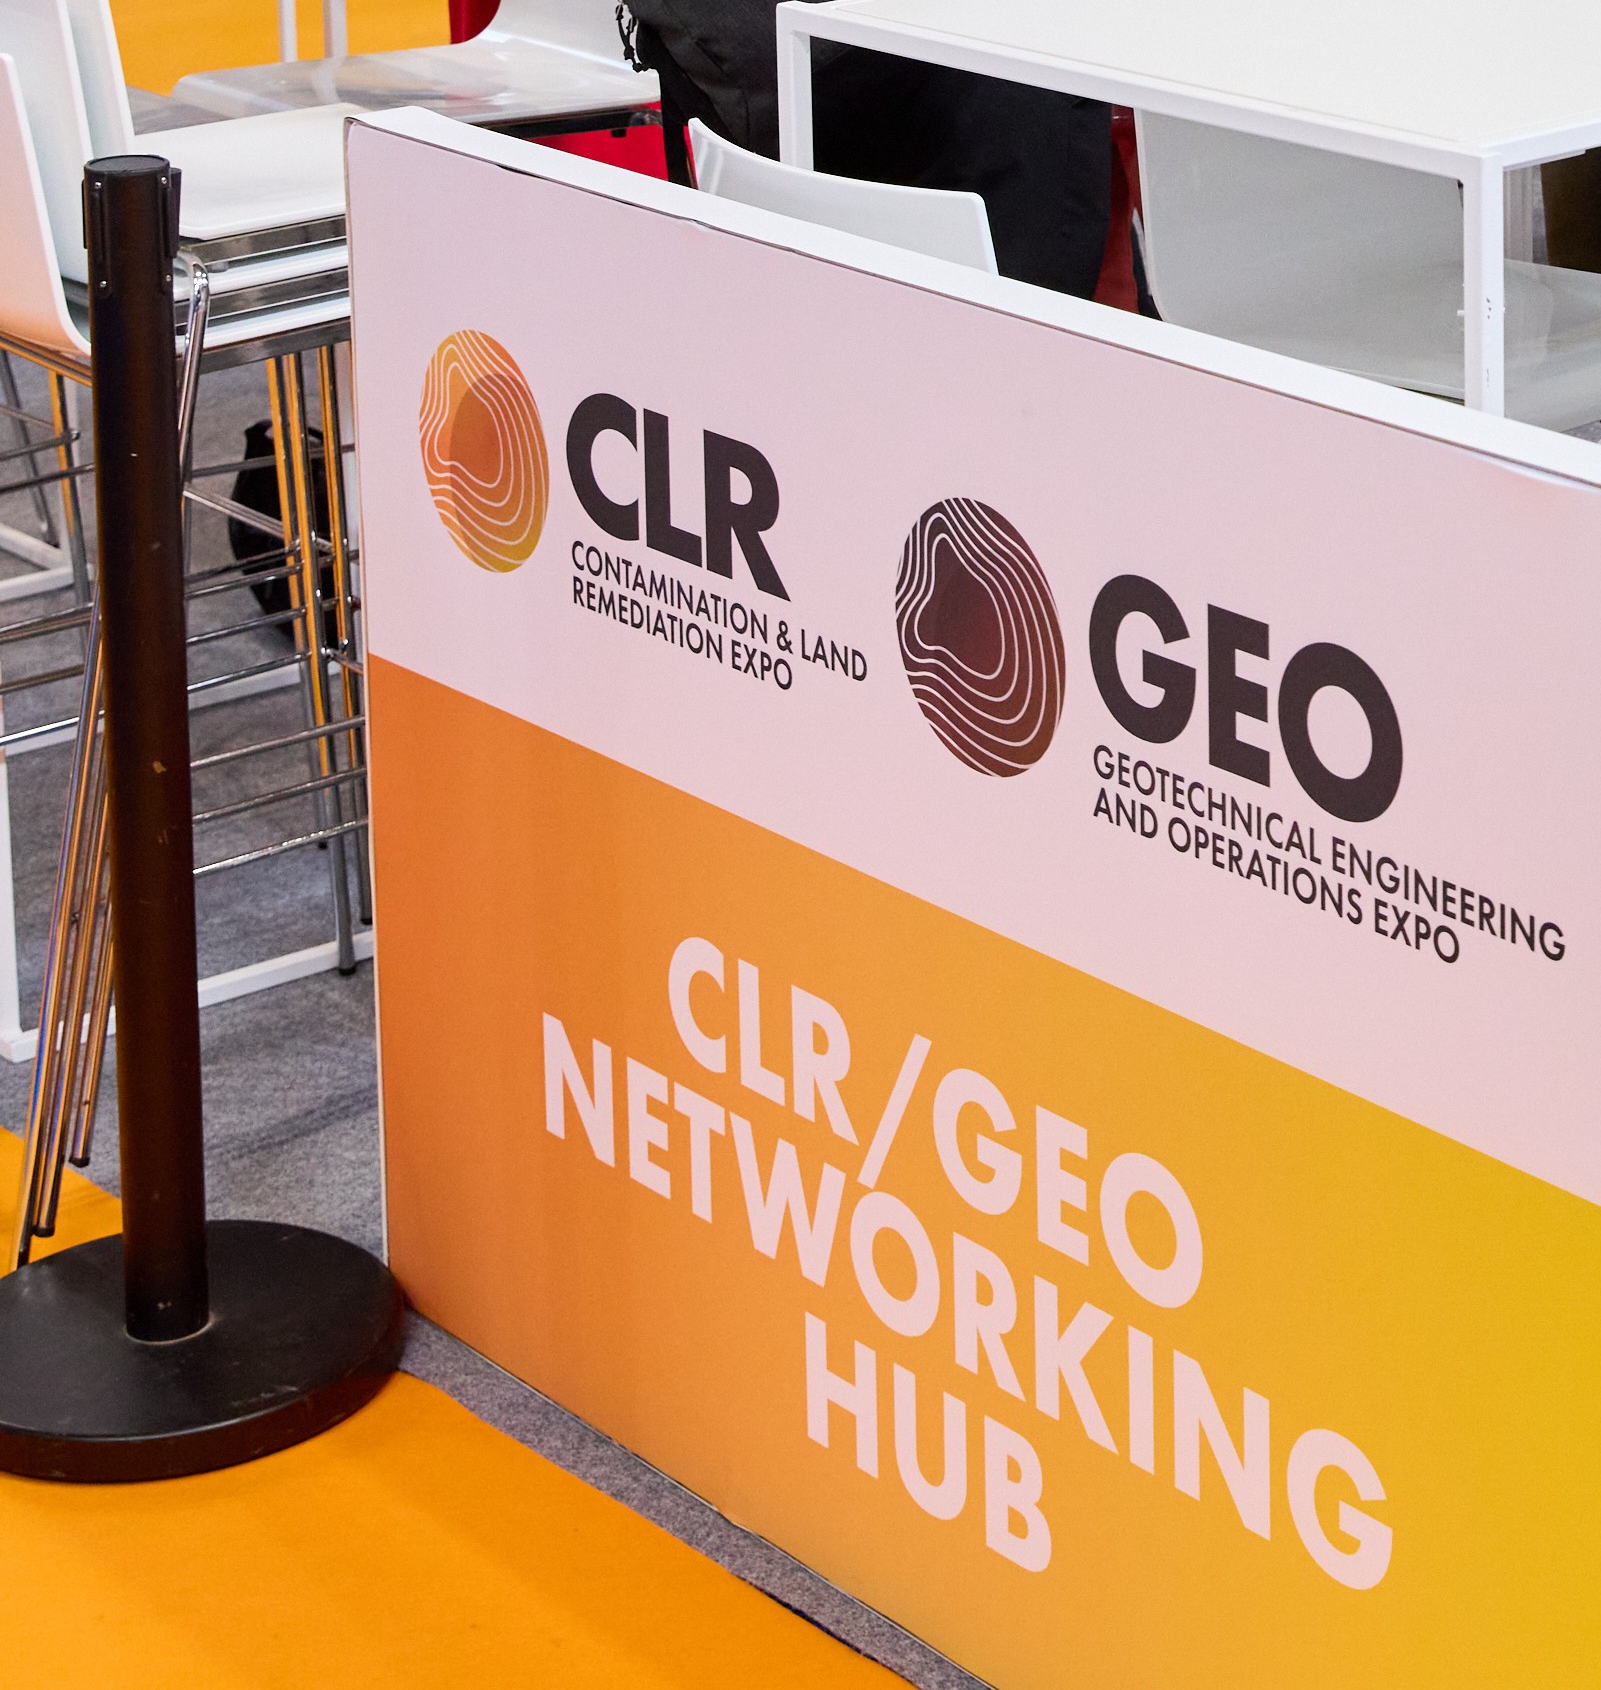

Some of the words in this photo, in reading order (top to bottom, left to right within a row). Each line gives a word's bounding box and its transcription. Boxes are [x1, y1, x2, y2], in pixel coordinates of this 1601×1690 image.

[566, 392, 791, 602] CLR
[571, 540, 768, 645] CONTAMINATION
[776, 620, 794, 654] &
[801, 628, 868, 682] LAND
[572, 576, 724, 665] REMEDIATION
[732, 640, 793, 691] EXPO
[1088, 573, 1404, 823] GEO
[1092, 787, 1159, 840] AND
[1168, 816, 1363, 926] OPERATIONS
[1373, 901, 1460, 964] EXPO
[1093, 744, 1322, 866] GEOTECHNICAL
[1332, 836, 1567, 962] ENGINEERING
[667, 936, 1204, 1309] CLR/GEO
[542, 1010, 1394, 1591] NETWORKING
[804, 1310, 1053, 1573] HUB
